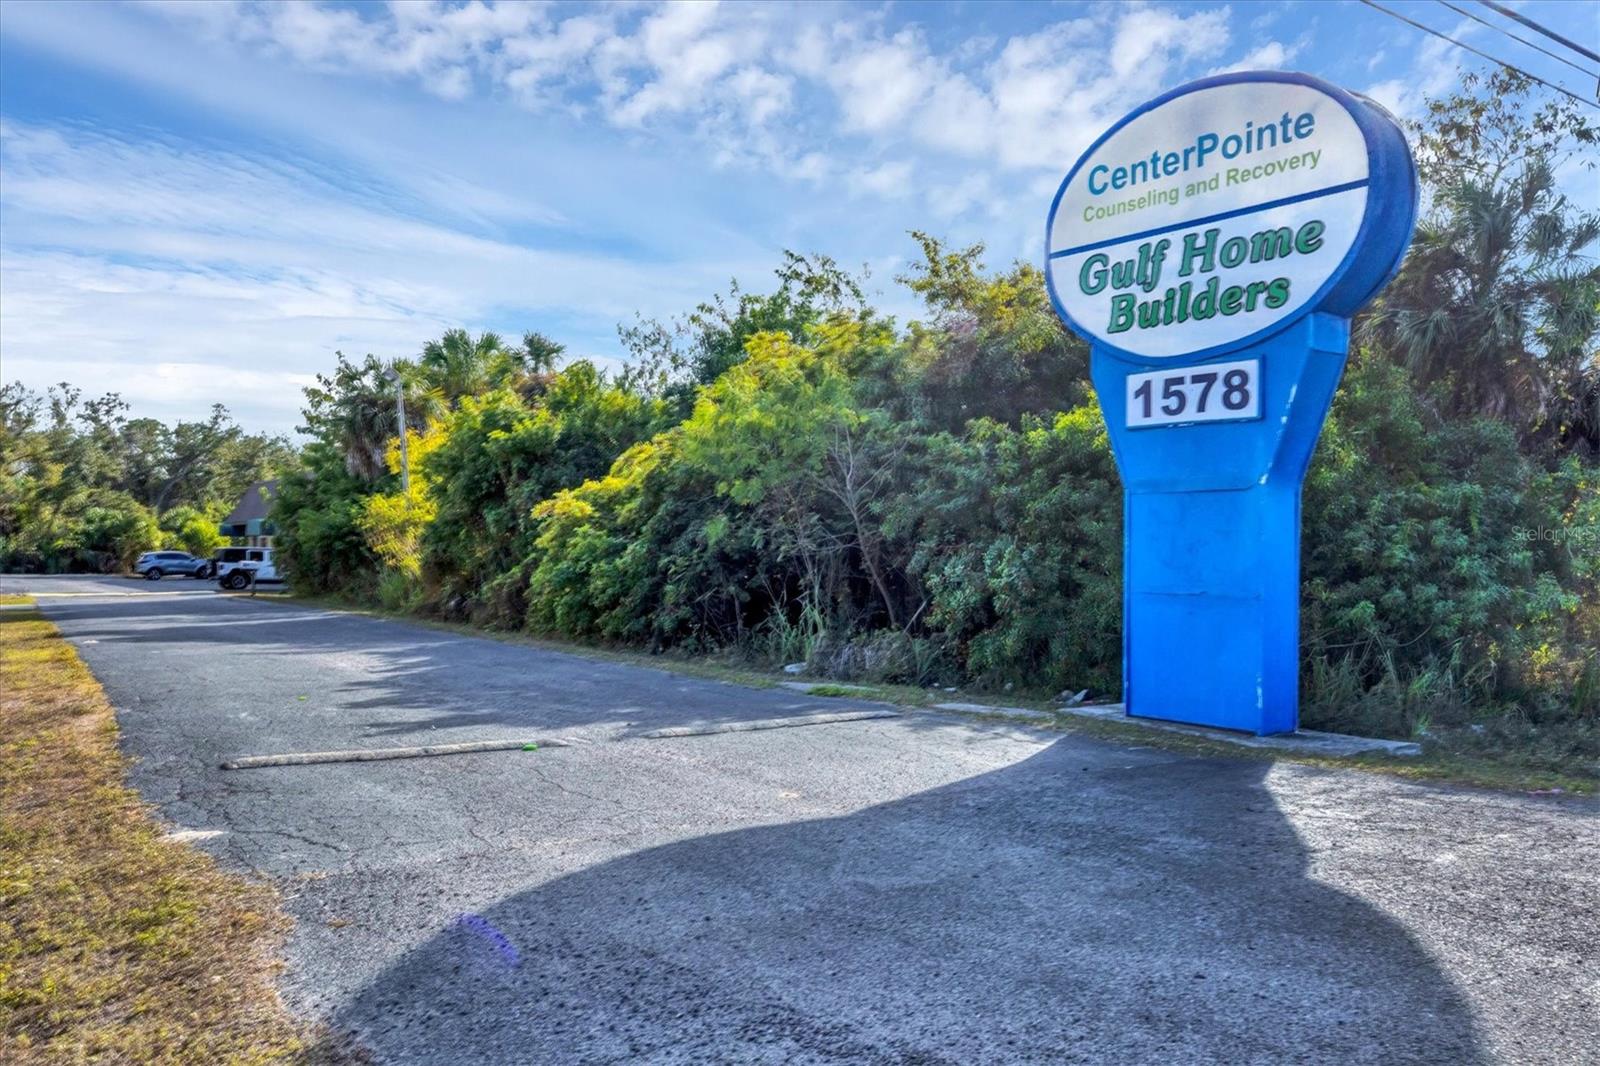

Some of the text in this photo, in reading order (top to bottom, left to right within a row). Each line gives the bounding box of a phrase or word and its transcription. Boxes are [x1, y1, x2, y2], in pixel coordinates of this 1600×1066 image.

[1084, 150, 1322, 222] Counseling and Recovery
[1088, 111, 1315, 196] CenterPointe
[1079, 220, 1325, 295] Gulf Home
[1107, 276, 1291, 334] Builders
[1133, 369, 1250, 419] 1578
